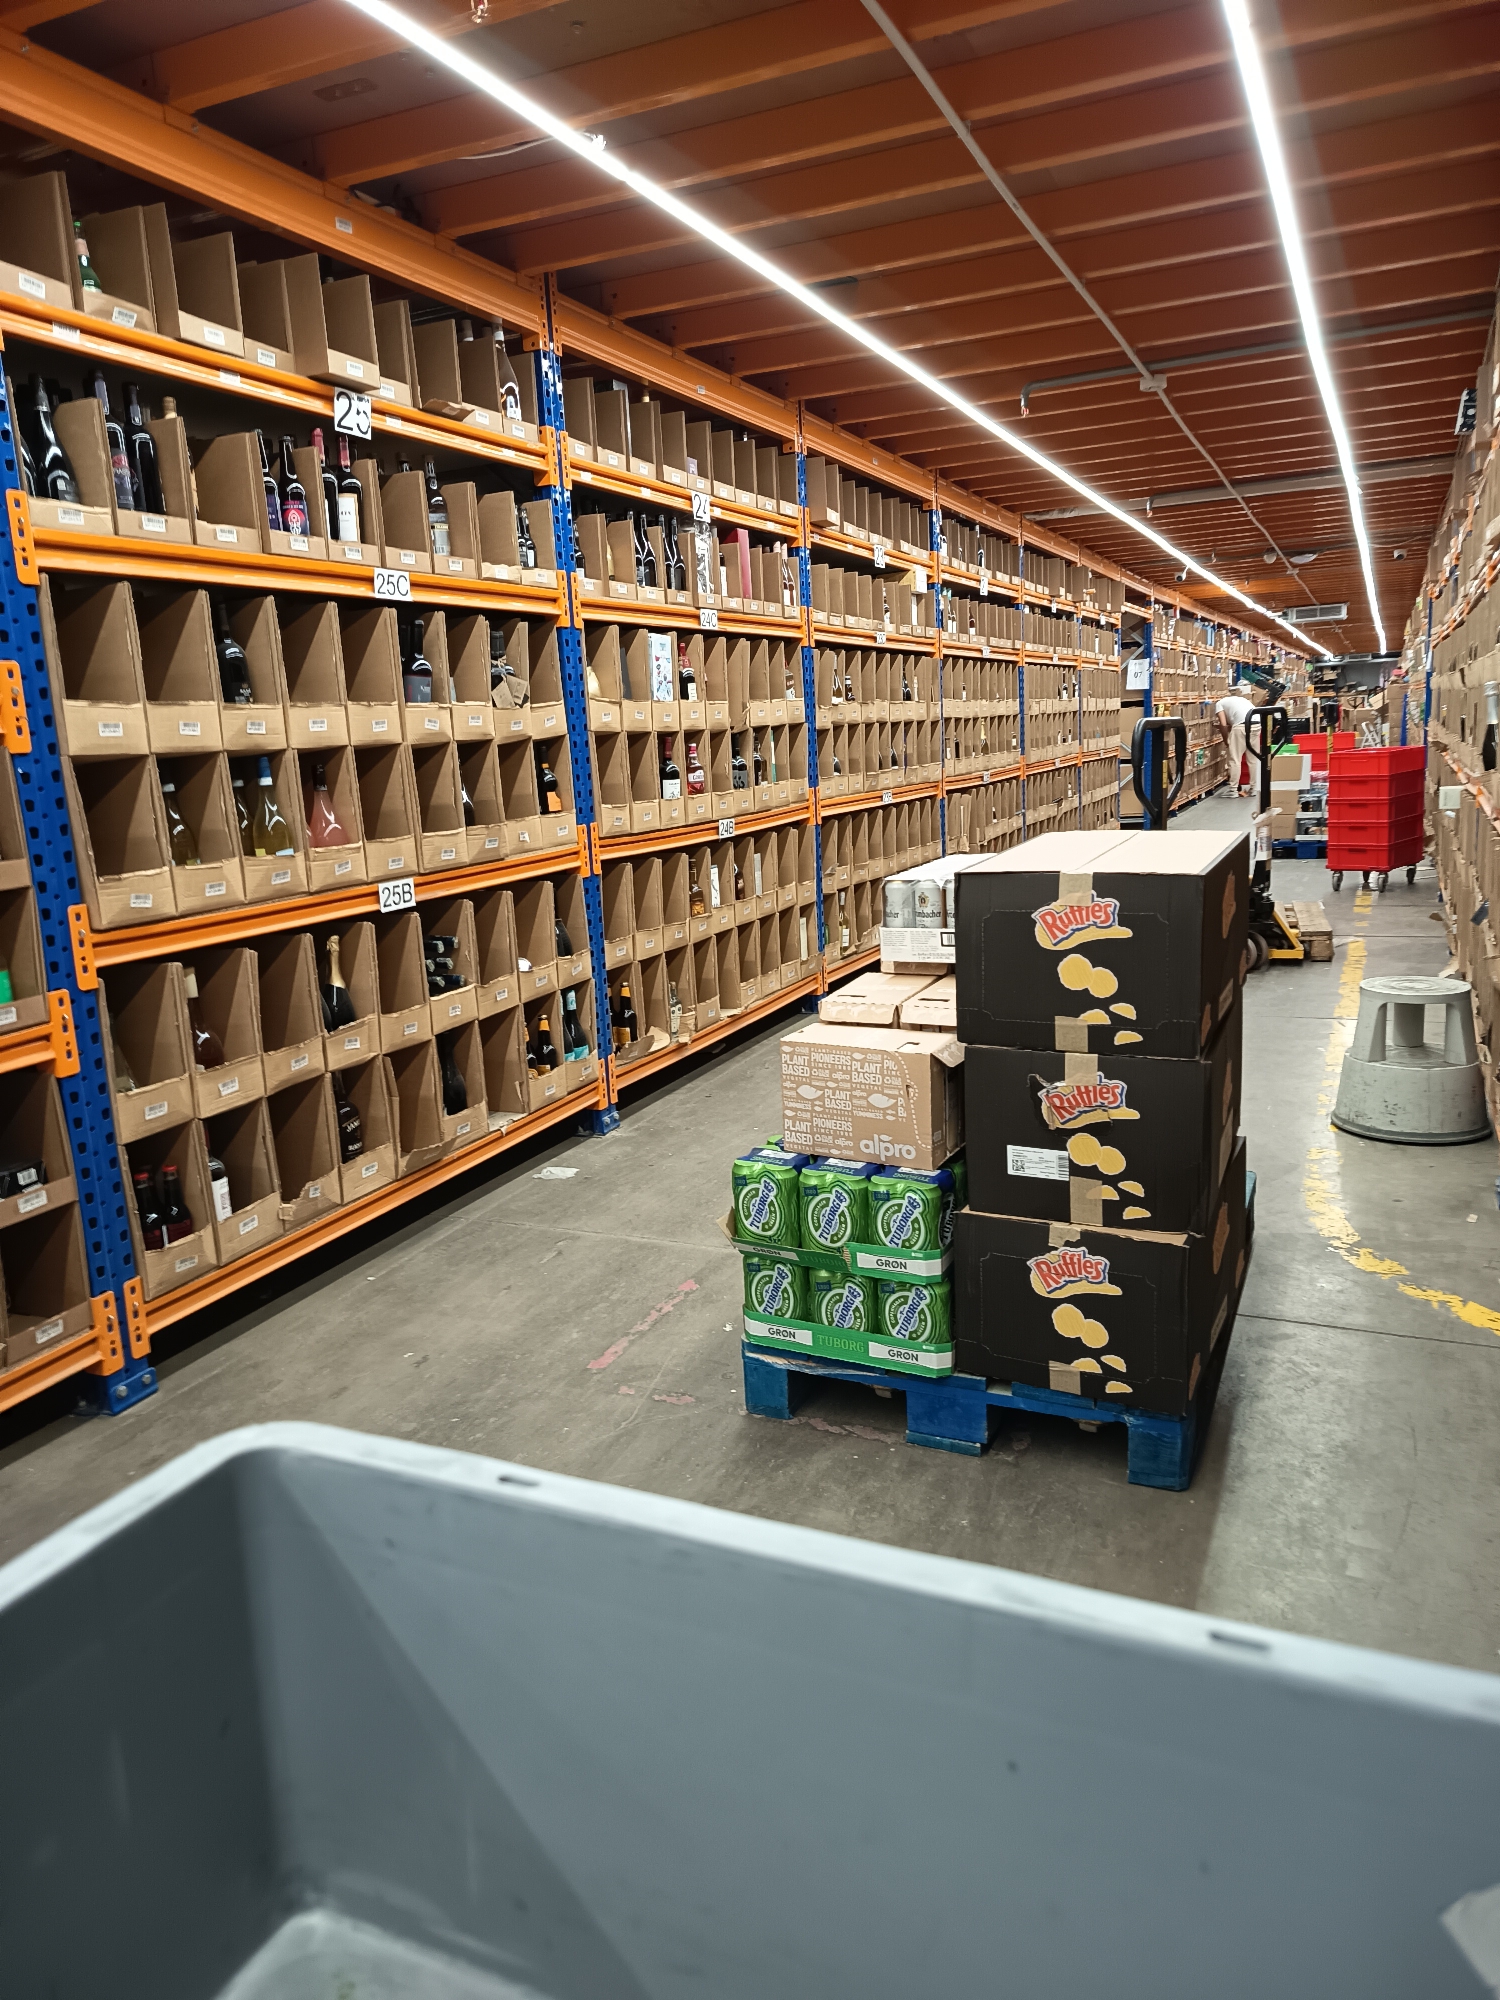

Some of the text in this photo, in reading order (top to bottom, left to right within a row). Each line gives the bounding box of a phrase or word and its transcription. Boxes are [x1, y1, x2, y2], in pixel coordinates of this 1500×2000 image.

[376, 573, 409, 597] 25C
[701, 612, 717, 628] 24C
[720, 821, 734, 836] 24B
[381, 883, 413, 908] 25B
[1038, 902, 1114, 943] Ruffles
[781, 1053, 810, 1067] PLANT
[811, 1052, 852, 1066] PIONEERS
[781, 1063, 810, 1077] BASED
[852, 1060, 883, 1075] PLANT
[852, 1071, 883, 1085] BASED
[824, 1088, 851, 1101] PLANT
[824, 1098, 852, 1111] BASED
[1043, 1084, 1122, 1122] Ruffles
[784, 1118, 812, 1133] PLANT
[812, 1117, 853, 1132] PIONEERS
[784, 1130, 813, 1145] BASED
[859, 1133, 916, 1161] alpro
[749, 1188, 771, 1230] TUBORG
[818, 1198, 843, 1241] TUBORG
[888, 1204, 915, 1247] TUBORG
[875, 1257, 908, 1271] GRØN
[1032, 1251, 1104, 1291] Ruffles
[762, 1275, 785, 1316] TUBORG
[835, 1294, 857, 1328] UBORG
[895, 1296, 922, 1339] TUBORG
[767, 1327, 797, 1340] GRØN
[816, 1334, 865, 1354] TUBORG
[887, 1348, 919, 1363] GRØN
